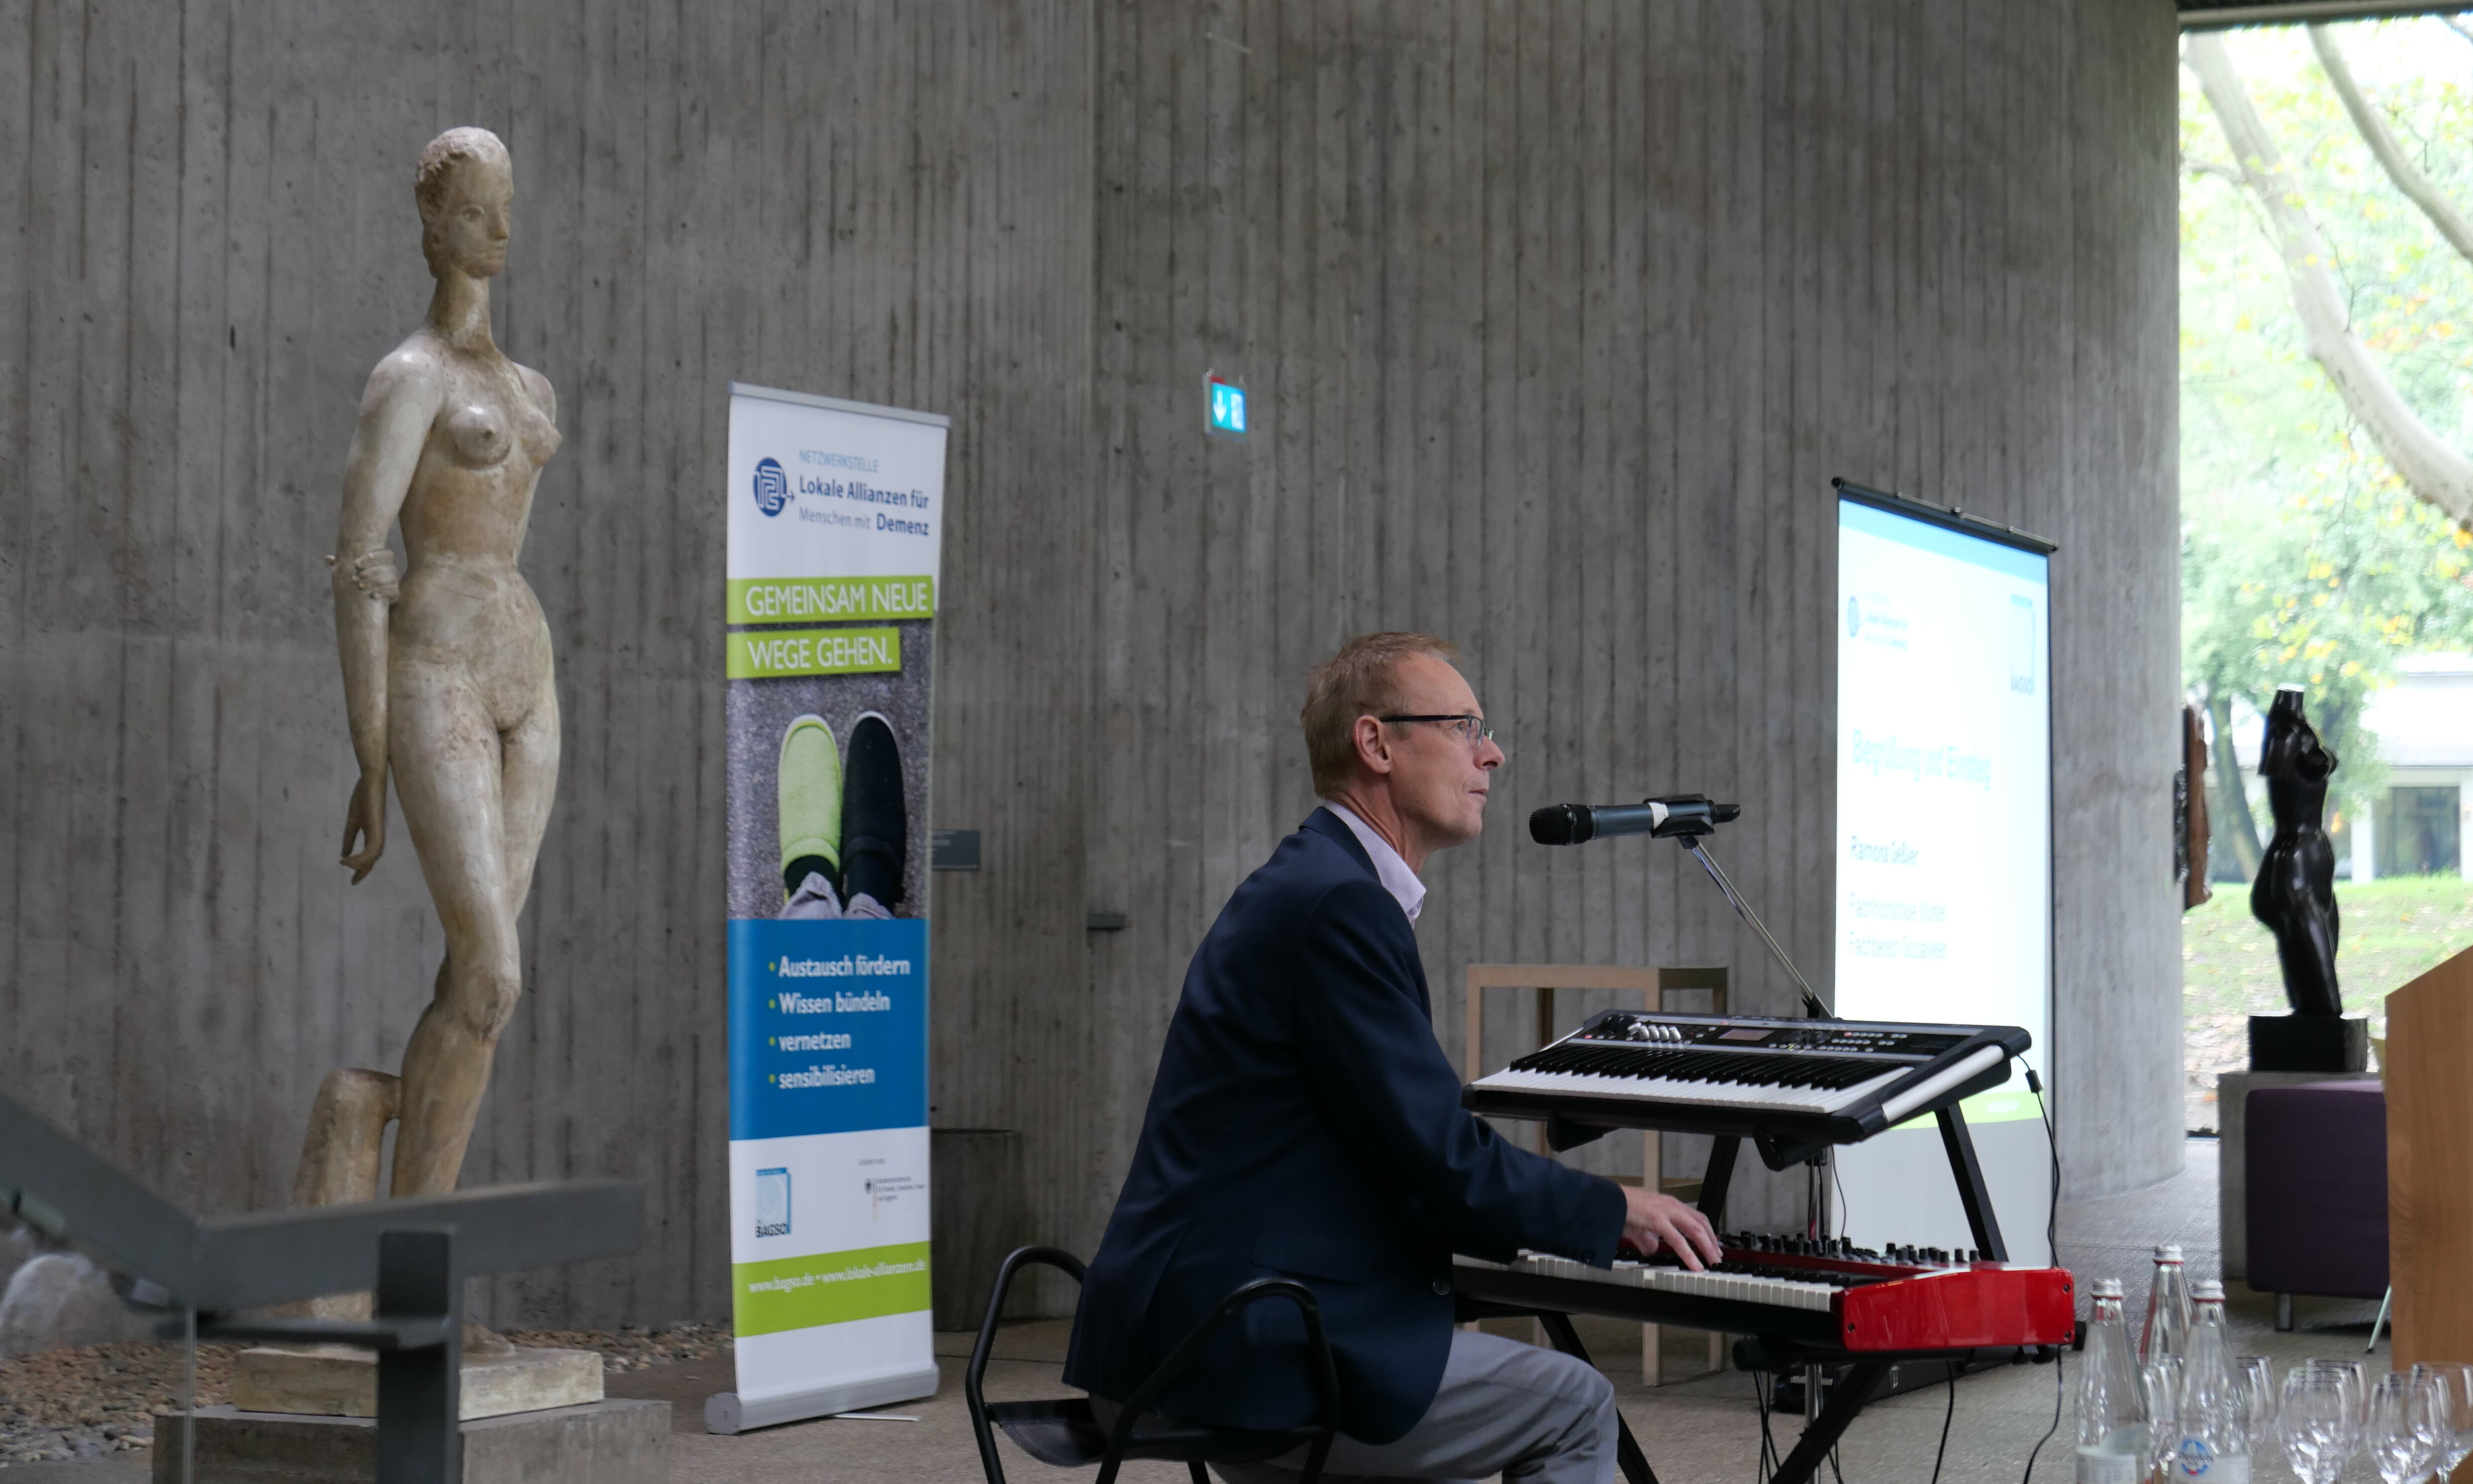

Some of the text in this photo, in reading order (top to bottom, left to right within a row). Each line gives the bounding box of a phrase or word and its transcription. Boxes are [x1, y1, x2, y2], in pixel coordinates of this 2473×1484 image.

[799, 449, 878, 473] NETZWERKSTELLE
[800, 475, 929, 509] Lokale Allianzen für
[799, 506, 929, 536] Menschen mit Demenz
[746, 582, 928, 616] GEMEINSAM NEUE
[747, 636, 893, 669] WEGE GEHEN.
[778, 954, 911, 977] Austausch fördern
[778, 990, 891, 1014] Wissen bündeln
[778, 1032, 851, 1052] vernetzen
[778, 1064, 875, 1089] sensibilisieren
[755, 1223, 786, 1238] BAGSO
[748, 1258, 926, 1293] www.bagso.de www.lokale-allianzen.de
